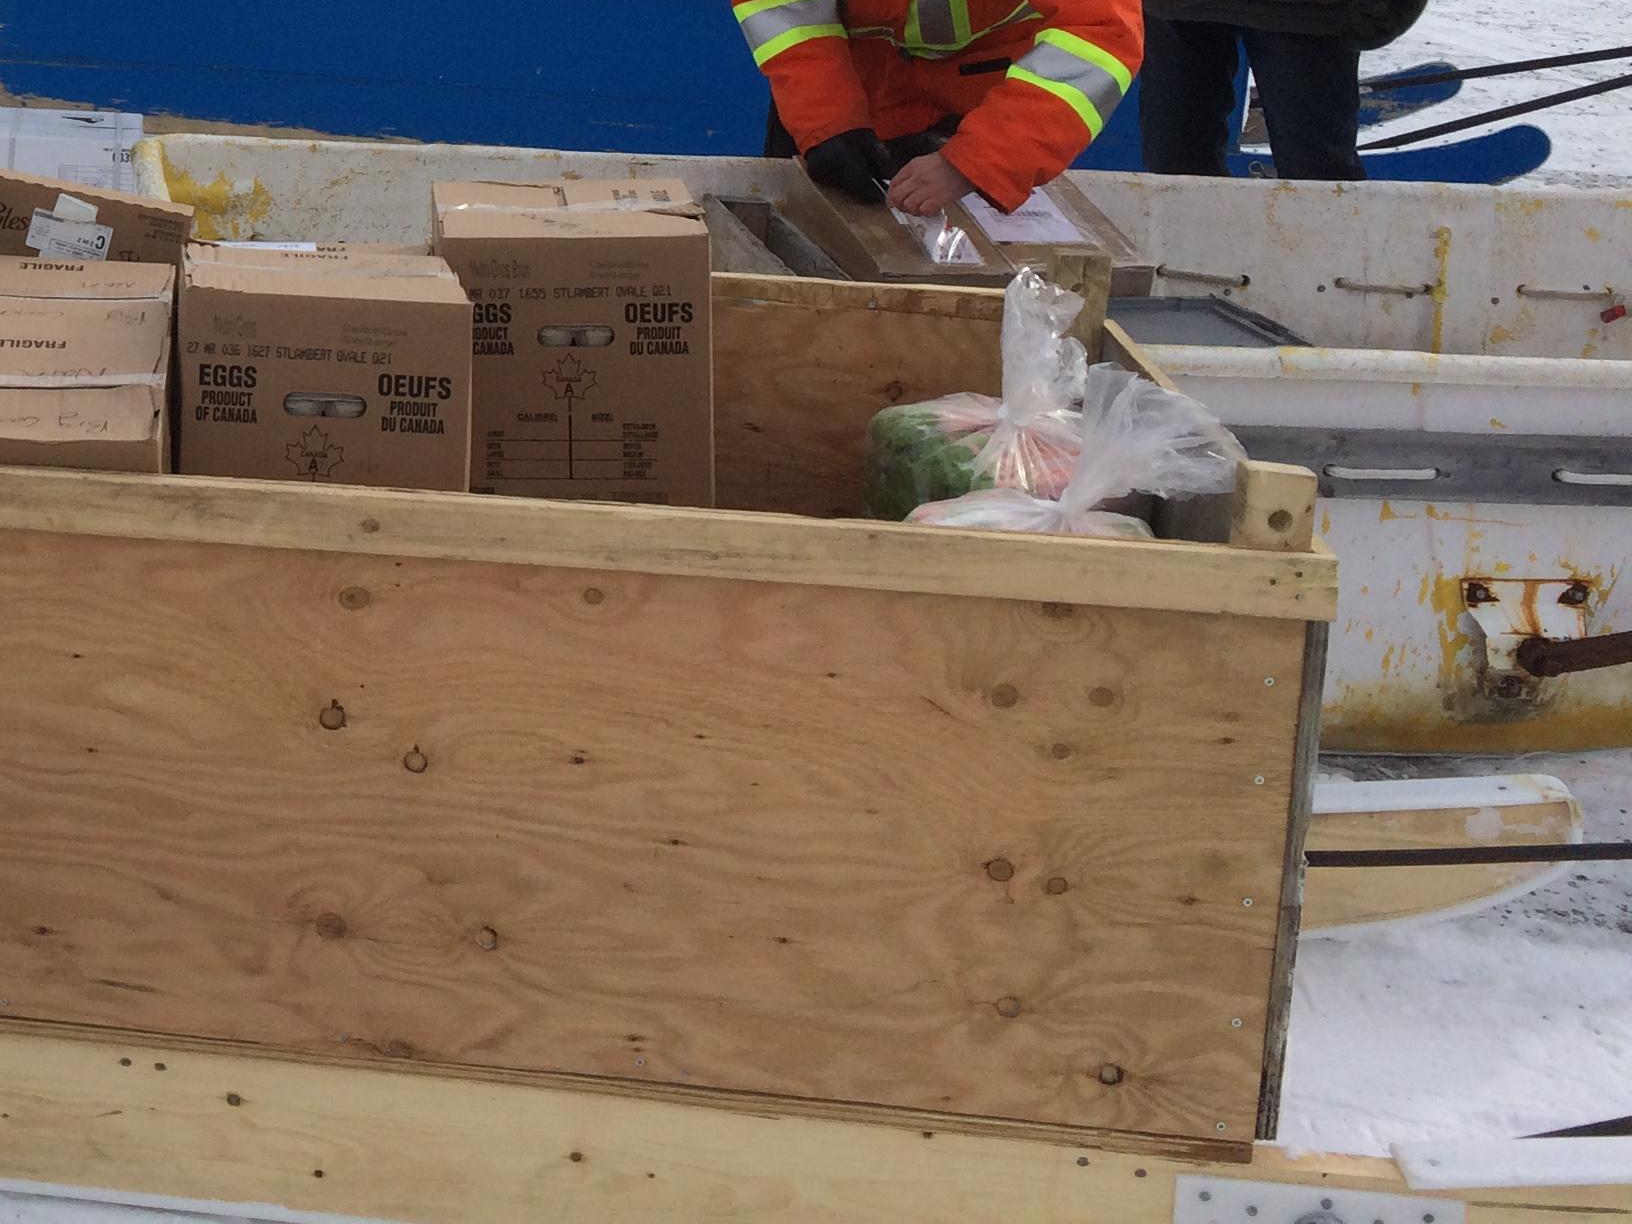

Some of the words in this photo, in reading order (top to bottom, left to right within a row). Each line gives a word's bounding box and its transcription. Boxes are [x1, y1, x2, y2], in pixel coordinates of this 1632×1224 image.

[19, 261, 85, 272] FRAGILE
[488, 287, 511, 300] 037
[553, 286, 611, 299] STLAMBERT
[472, 302, 513, 324] GGS
[624, 301, 694, 325] OEUFS
[472, 326, 509, 341] ODUCT
[635, 326, 682, 341] PRODUIT
[186, 341, 201, 355] 27
[221, 343, 242, 357] 036
[275, 346, 333, 363] STLAMBERT
[472, 341, 515, 356] CANADA
[629, 340, 645, 355] DU
[646, 340, 690, 356] CANADA
[198, 363, 258, 388] EGGS
[377, 373, 453, 400] OEUFS
[563, 383, 575, 396] A
[201, 389, 253, 407] PRODUCT
[194, 406, 210, 422] OF
[212, 406, 258, 424] CANADA
[389, 400, 438, 418] PRODUIT
[380, 416, 396, 433] DU
[399, 417, 446, 435] CANADA
[308, 458, 319, 472] A
